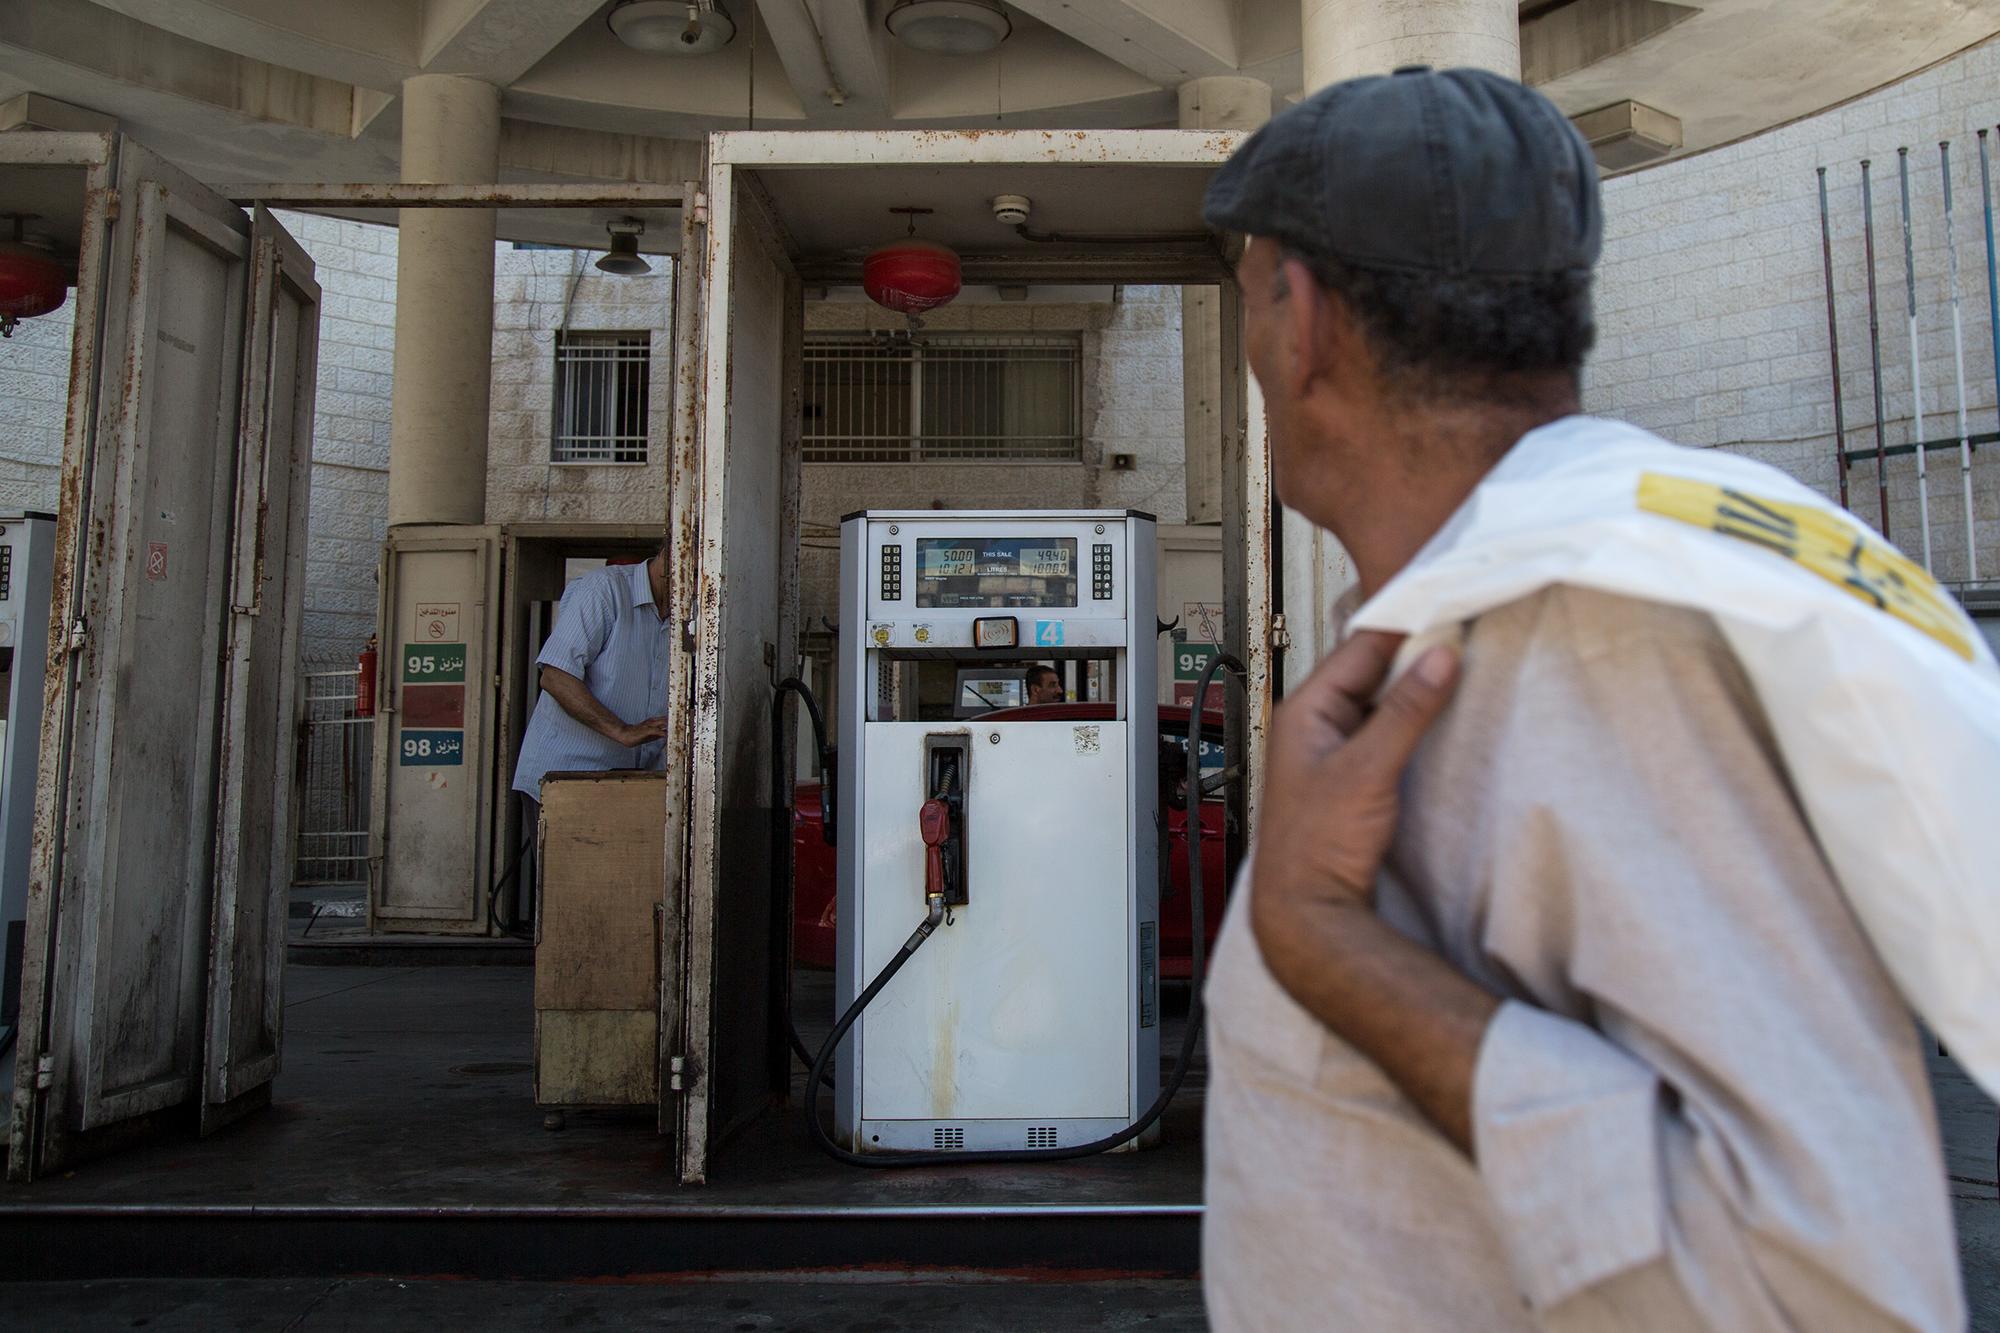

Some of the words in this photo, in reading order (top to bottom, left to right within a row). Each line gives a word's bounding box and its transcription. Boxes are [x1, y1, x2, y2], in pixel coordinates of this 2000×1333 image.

[1038, 550, 1067, 561] 49.40
[1041, 622, 1058, 644] 4
[408, 656, 435, 674] 95
[439, 656, 464, 672] بنزين
[1180, 654, 1208, 671] 95
[404, 739, 432, 757] 98
[435, 739, 460, 755] بنزين
